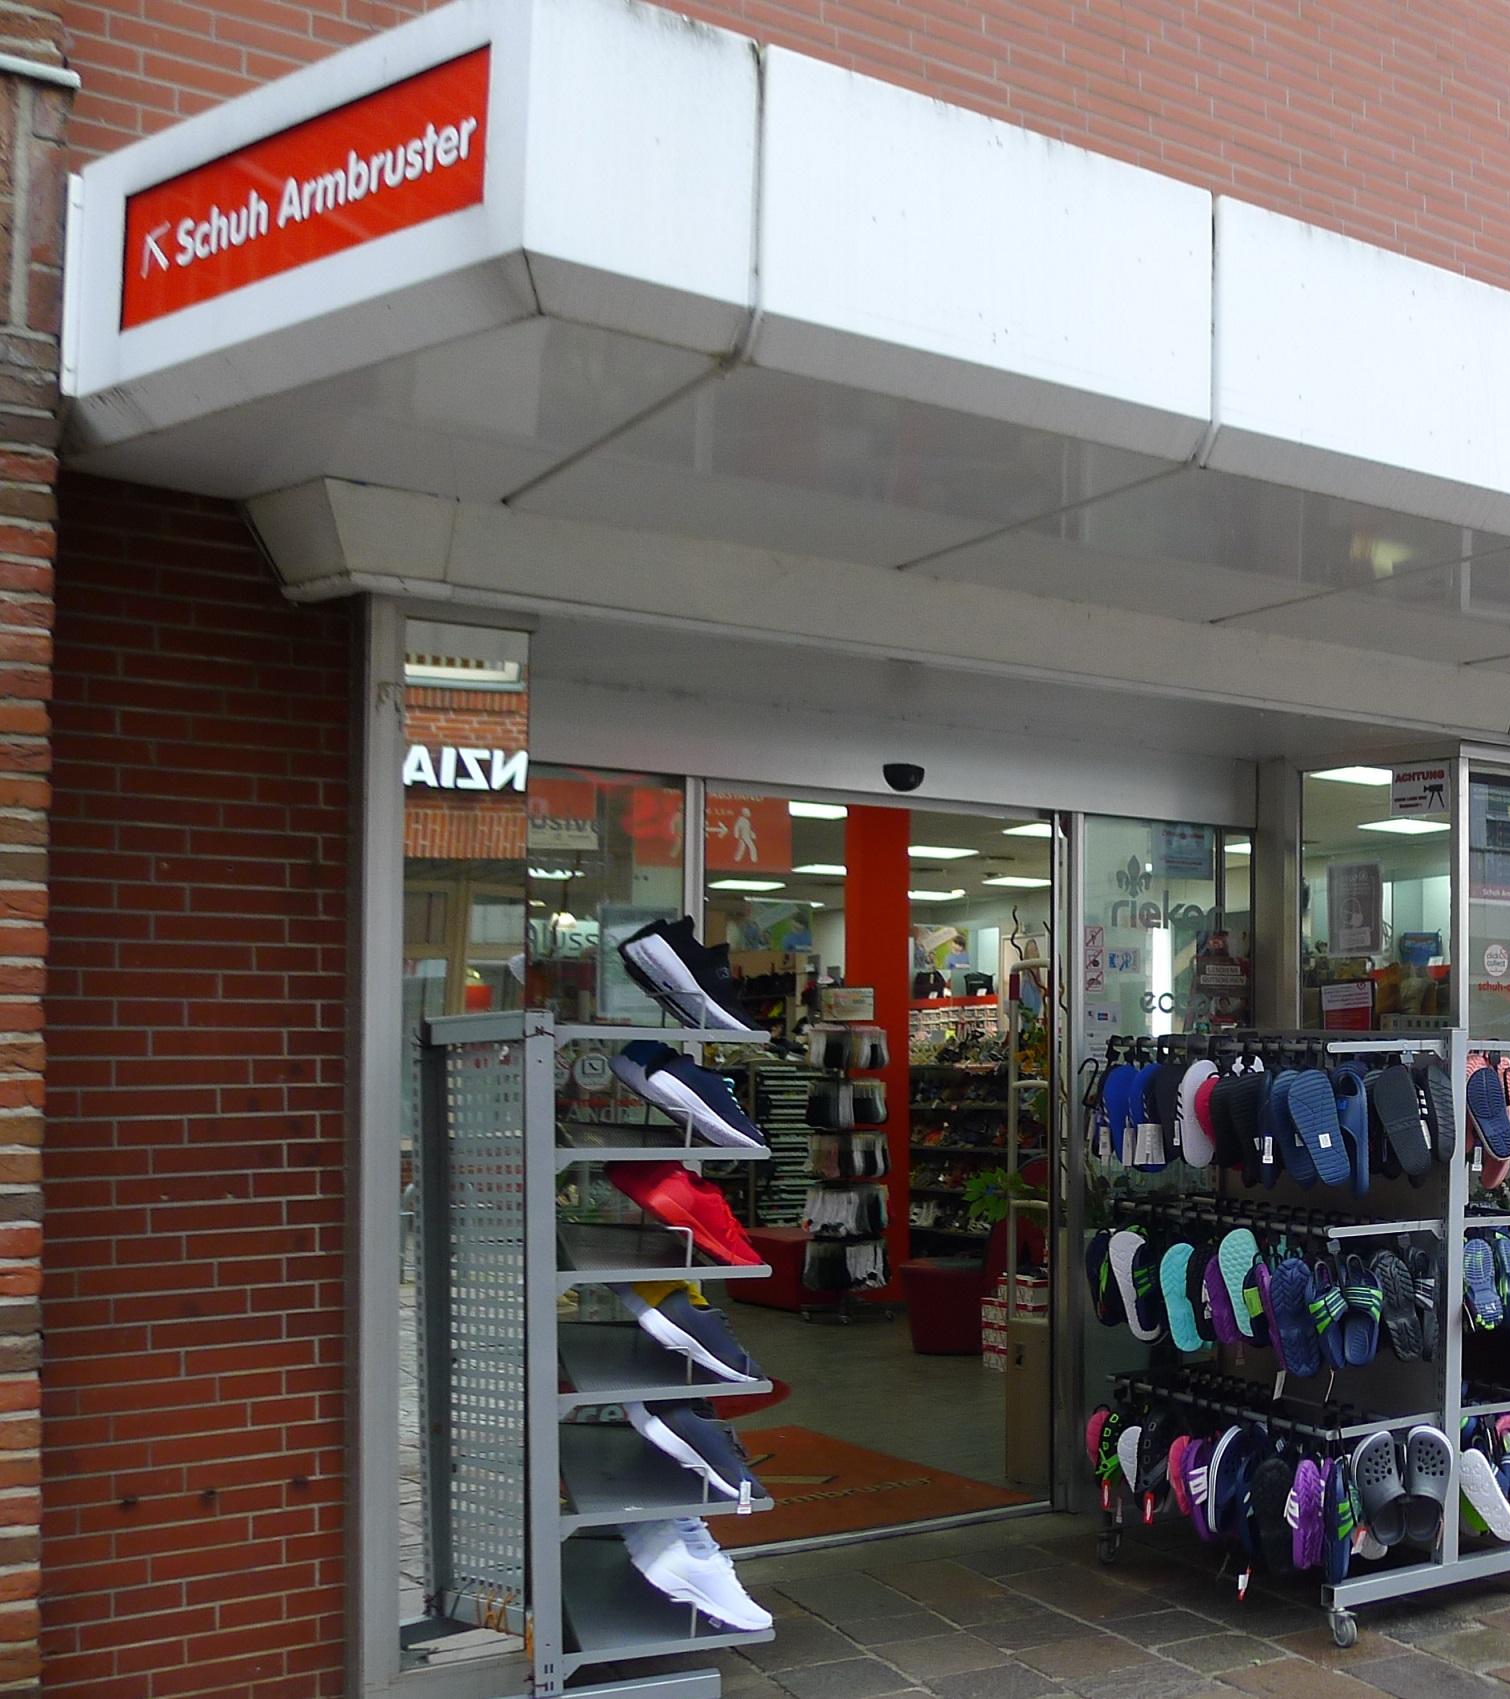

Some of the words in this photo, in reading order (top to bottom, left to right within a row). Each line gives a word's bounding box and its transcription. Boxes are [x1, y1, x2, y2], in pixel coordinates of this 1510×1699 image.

[176, 189, 269, 266] Schuh
[277, 116, 478, 228] Armbruster
[1395, 769, 1445, 784] ACHTUNG
